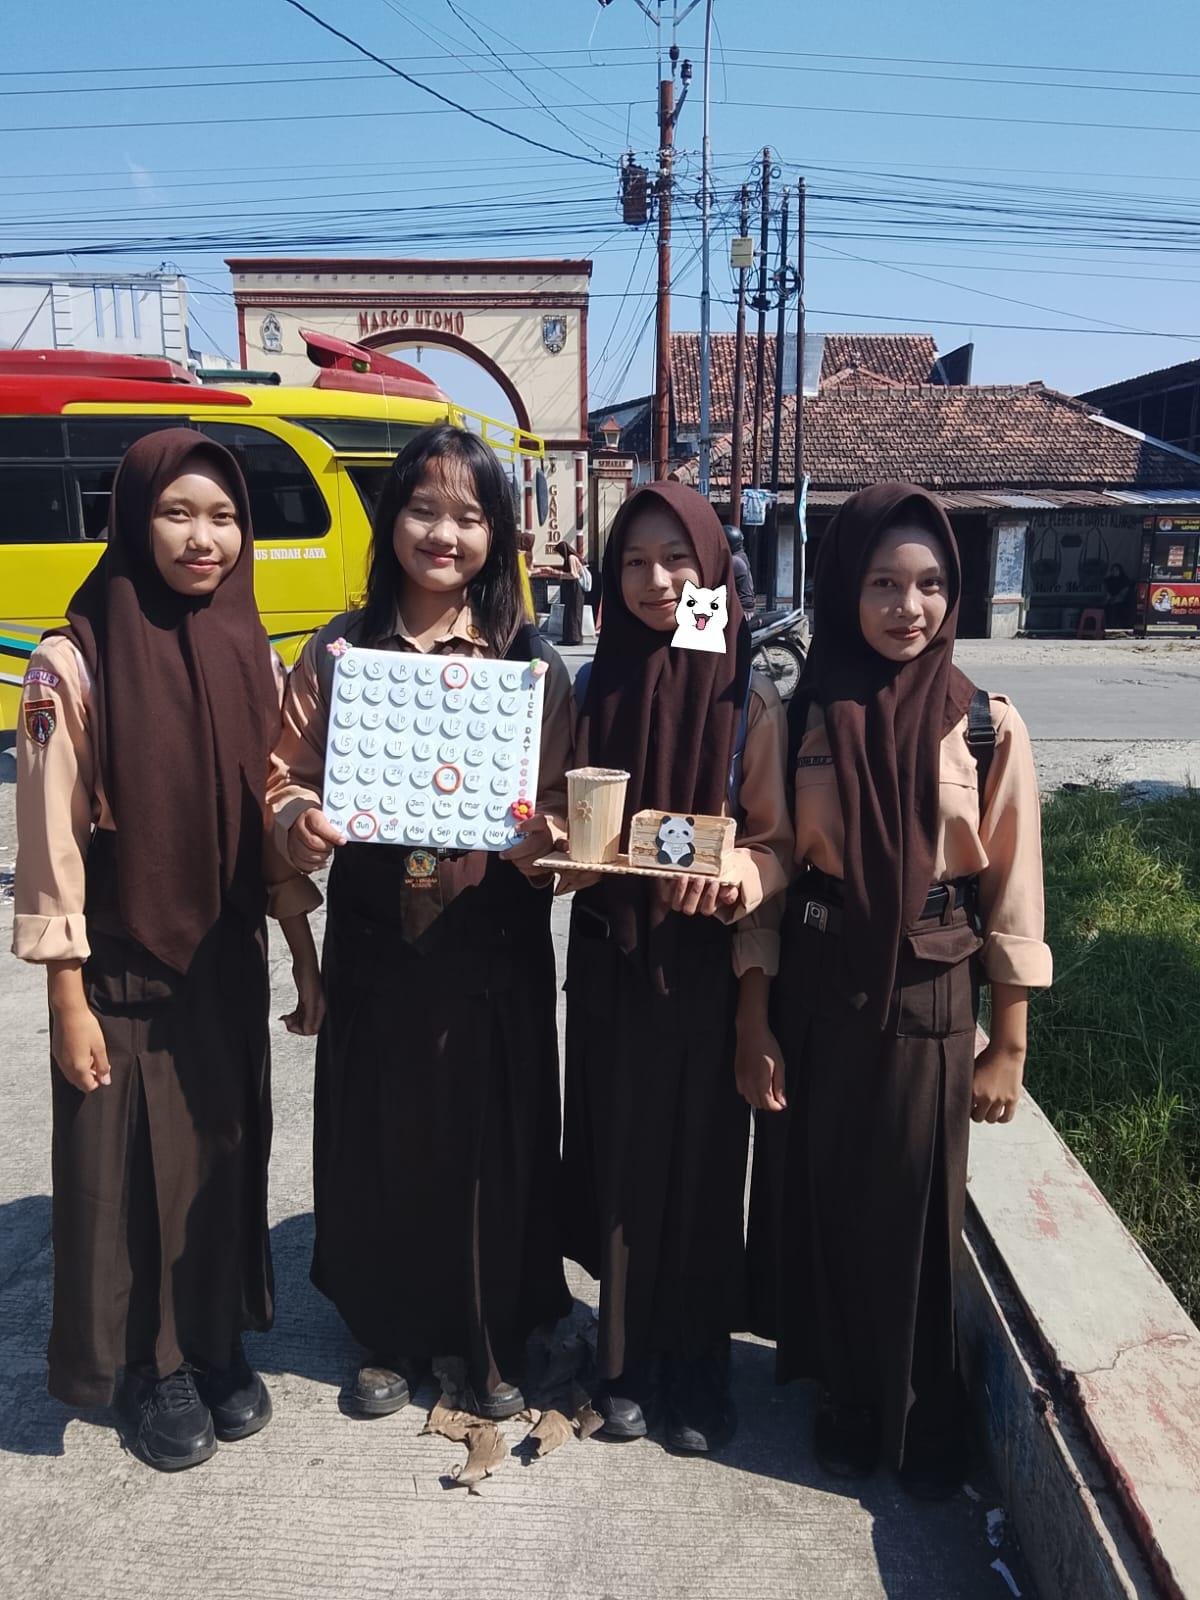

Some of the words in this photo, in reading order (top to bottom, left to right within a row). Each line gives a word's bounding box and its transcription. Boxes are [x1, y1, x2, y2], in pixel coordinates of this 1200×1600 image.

[358, 309, 409, 336] MARGO
[415, 309, 465, 336] UTOMO
[548, 484, 558, 530] GANG
[547, 531, 561, 542] 10
[270, 547, 302, 560] INDAH
[303, 547, 327, 559] JAYA
[347, 659, 356, 673] S
[372, 662, 380, 675] S
[399, 664, 407, 676] R
[424, 666, 431, 677] K
[452, 669, 459, 680] J
[480, 670, 488, 683] S
[425, 690, 433, 699] 4
[507, 696, 516, 708] 7
[527, 682, 536, 719] NICE
[344, 711, 352, 723] 8
[397, 713, 406, 723] 10
[449, 719, 461, 731] 12
[475, 720, 486, 733] 13
[504, 722, 514, 733] 14
[340, 735, 351, 747] 15
[394, 740, 402, 751] 17
[445, 747, 455, 758] 19
[471, 749, 483, 757] 20
[523, 726, 532, 753] DAY
[416, 770, 430, 778] 25
[356, 821, 370, 829] Jun
[437, 827, 451, 837] Sep
